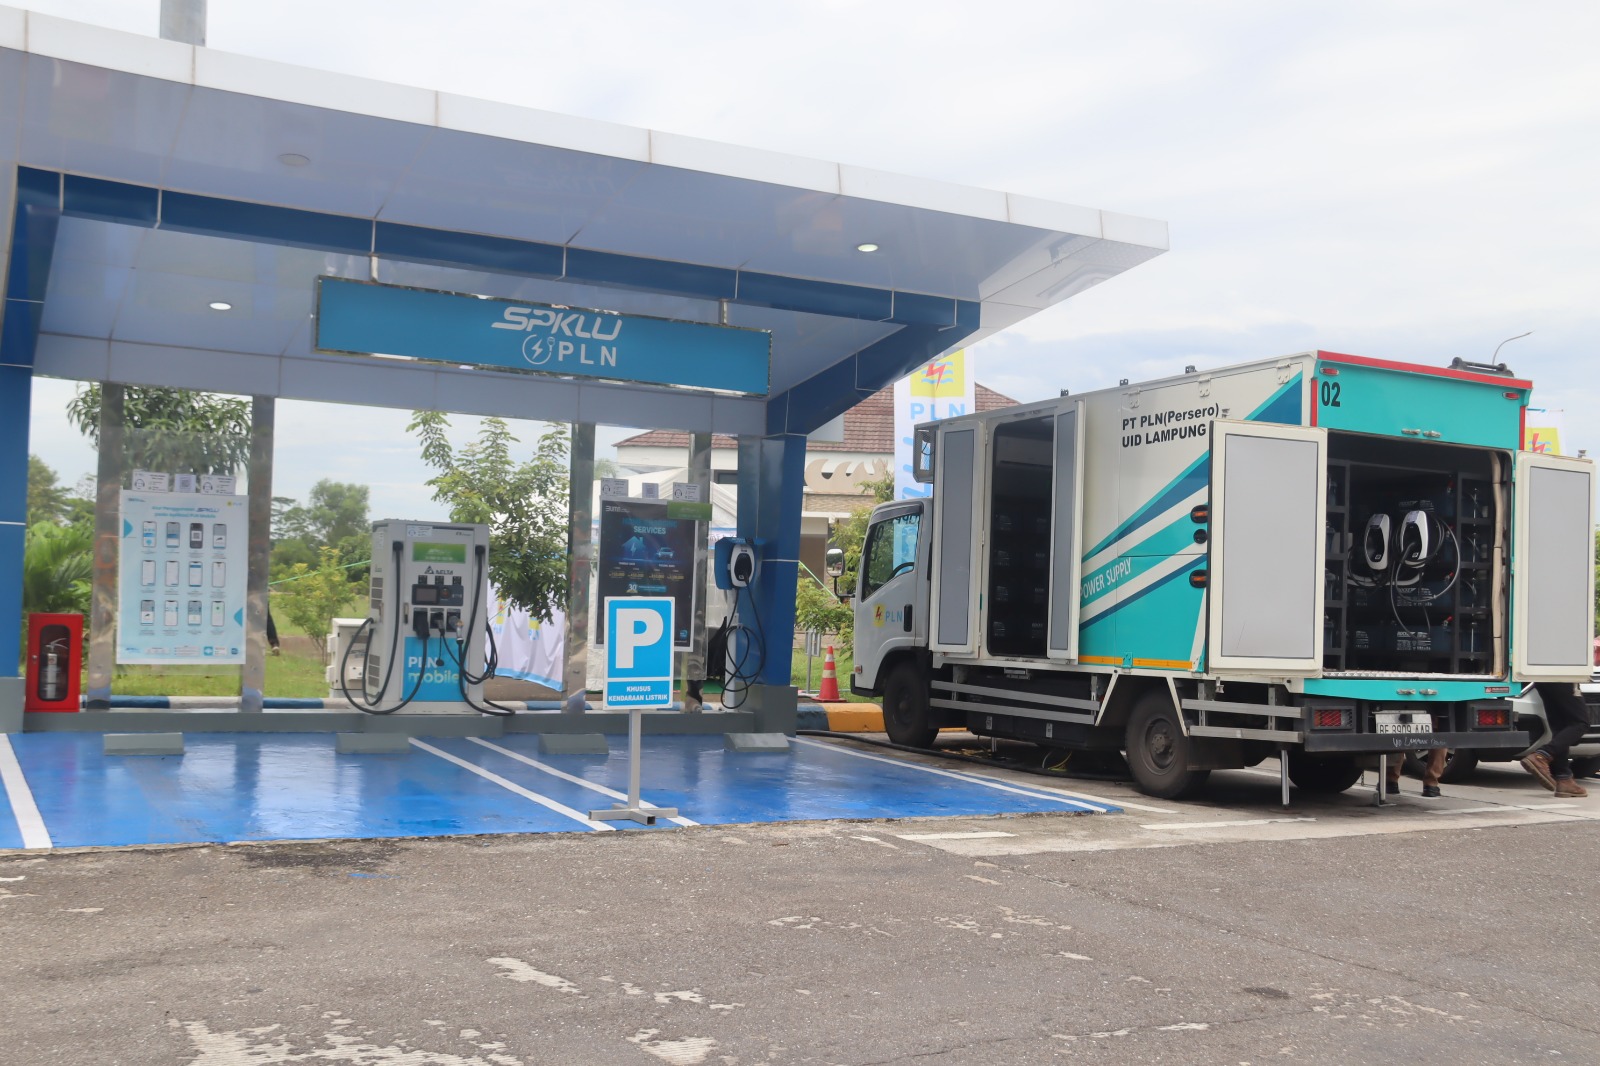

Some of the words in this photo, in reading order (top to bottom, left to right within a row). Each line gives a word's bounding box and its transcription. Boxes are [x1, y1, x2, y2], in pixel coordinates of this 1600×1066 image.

[491, 306, 622, 341] SPKLU
[558, 341, 617, 367] PLN
[1321, 381, 1341, 408] 02
[910, 403, 965, 420] PLN
[1122, 417, 1137, 430] PT
[1122, 434, 1142, 448] UID
[1146, 423, 1207, 445] LAMPUNG
[633, 525, 667, 535] SERVICES
[1080, 573, 1105, 599] OWER
[1105, 557, 1131, 586] SUPPLY
[885, 611, 903, 622] PLN
[616, 608, 664, 668] P
[408, 670, 460, 683] mobile
